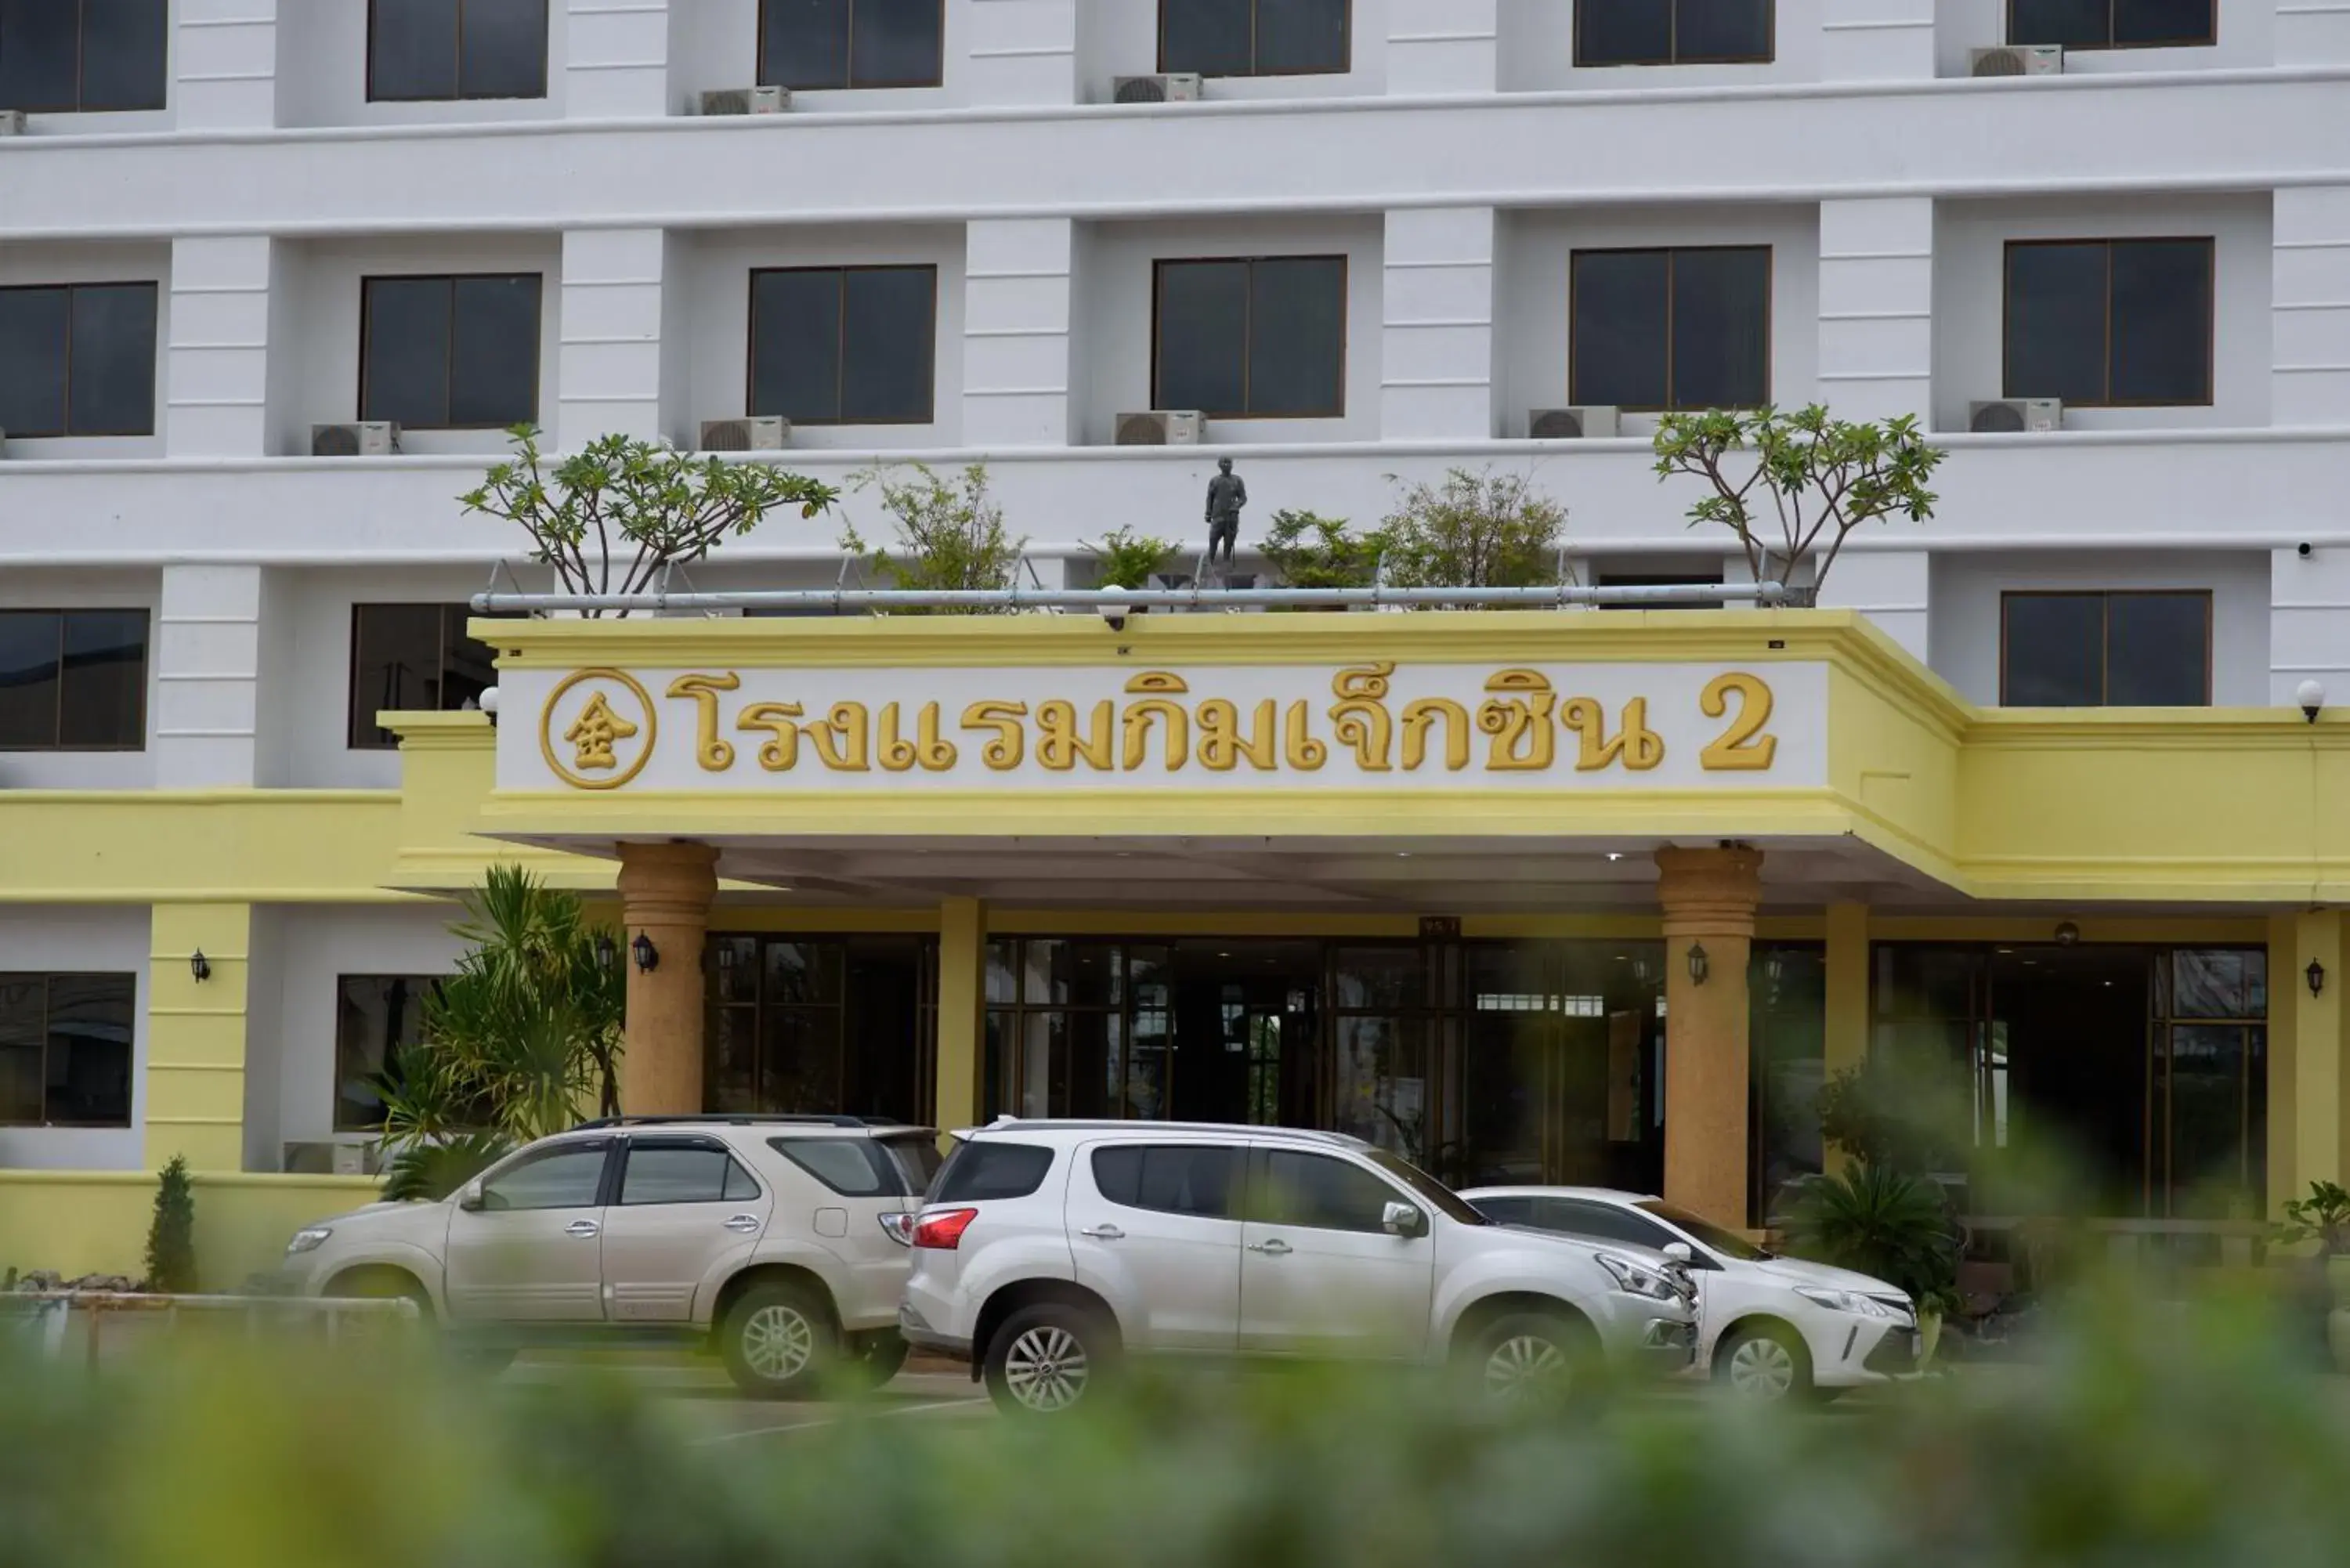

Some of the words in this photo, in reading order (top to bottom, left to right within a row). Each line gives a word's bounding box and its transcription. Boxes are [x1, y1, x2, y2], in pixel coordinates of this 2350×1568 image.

[564, 691, 638, 770] 金
[666, 662, 1665, 772] โรงแรมกิมเจ็กซิน
[1700, 671, 1777, 772] 2
